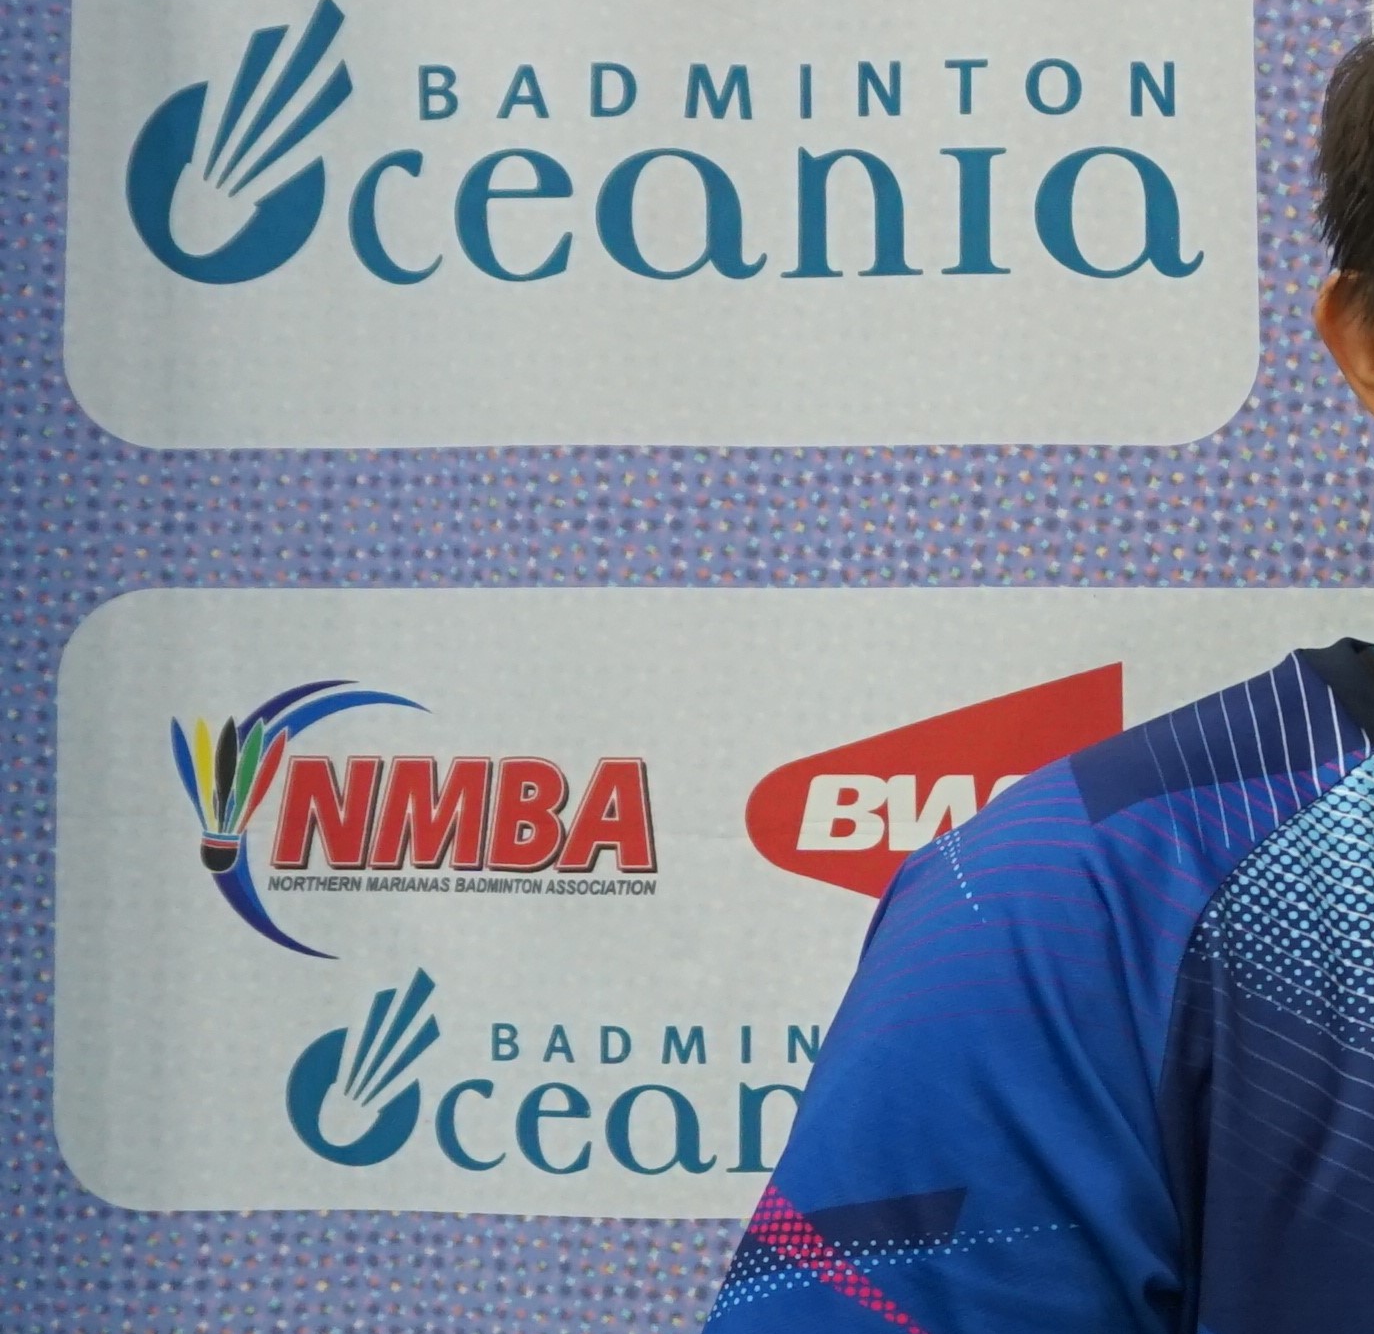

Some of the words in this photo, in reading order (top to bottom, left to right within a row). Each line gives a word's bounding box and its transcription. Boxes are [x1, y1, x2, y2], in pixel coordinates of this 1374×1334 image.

[418, 58, 1177, 121] BADMINTON
[270, 754, 658, 874] NMBA
[796, 774, 1031, 851] BW
[267, 875, 362, 893] NORTHERN
[366, 876, 451, 894] MARIANAS
[454, 877, 542, 895] BADMINTON
[545, 878, 657, 897] ASSOCIATION
[491, 1022, 820, 1065] BADMIN
[286, 1027, 805, 1175] Ocean
